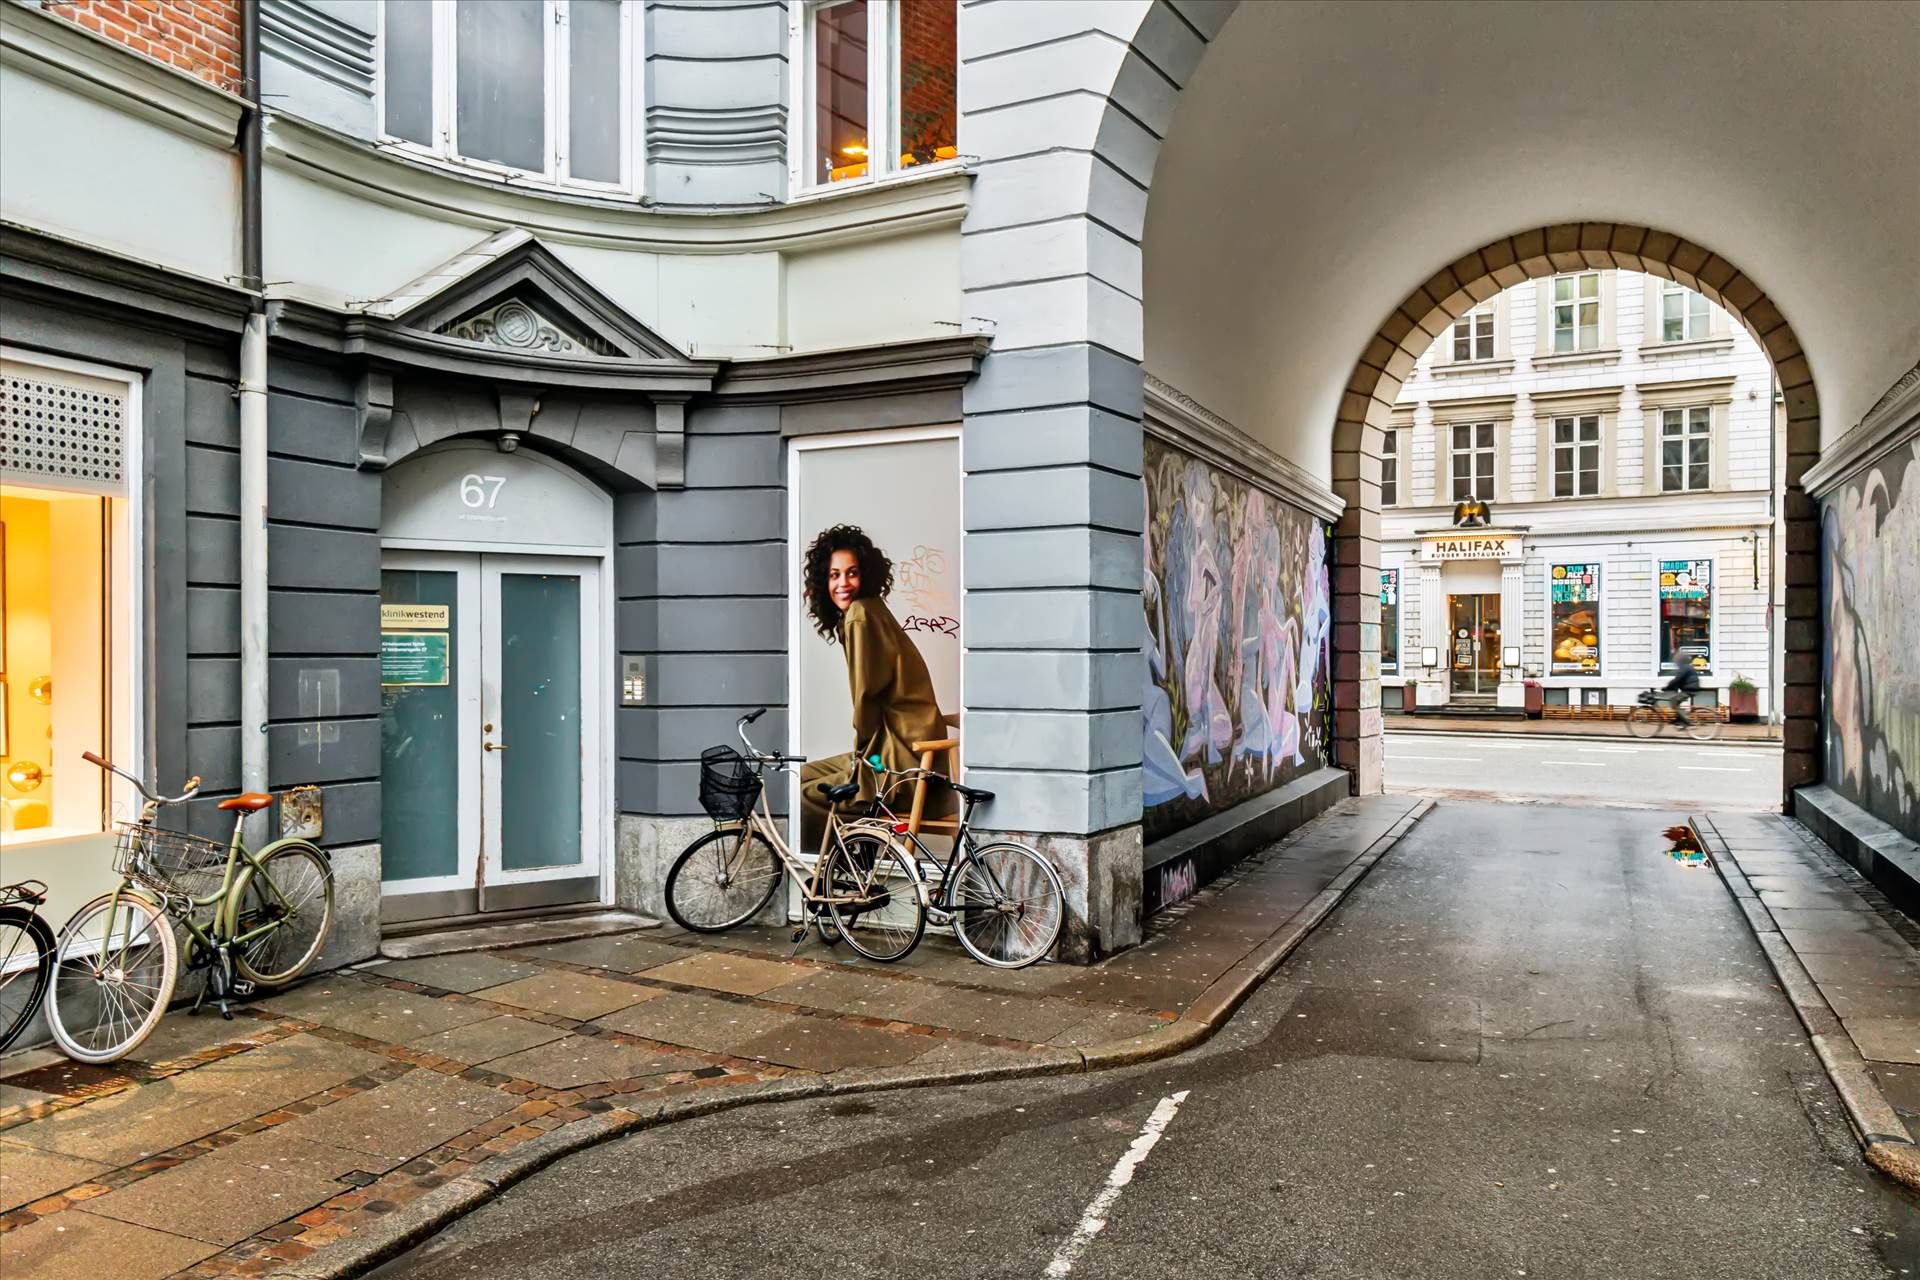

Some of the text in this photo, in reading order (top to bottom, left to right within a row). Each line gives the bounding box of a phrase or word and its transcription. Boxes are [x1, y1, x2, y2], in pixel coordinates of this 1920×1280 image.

[460, 474, 506, 508] 67
[1436, 540, 1505, 552] HALIFAX
[382, 609, 445, 618] klinikwestend
